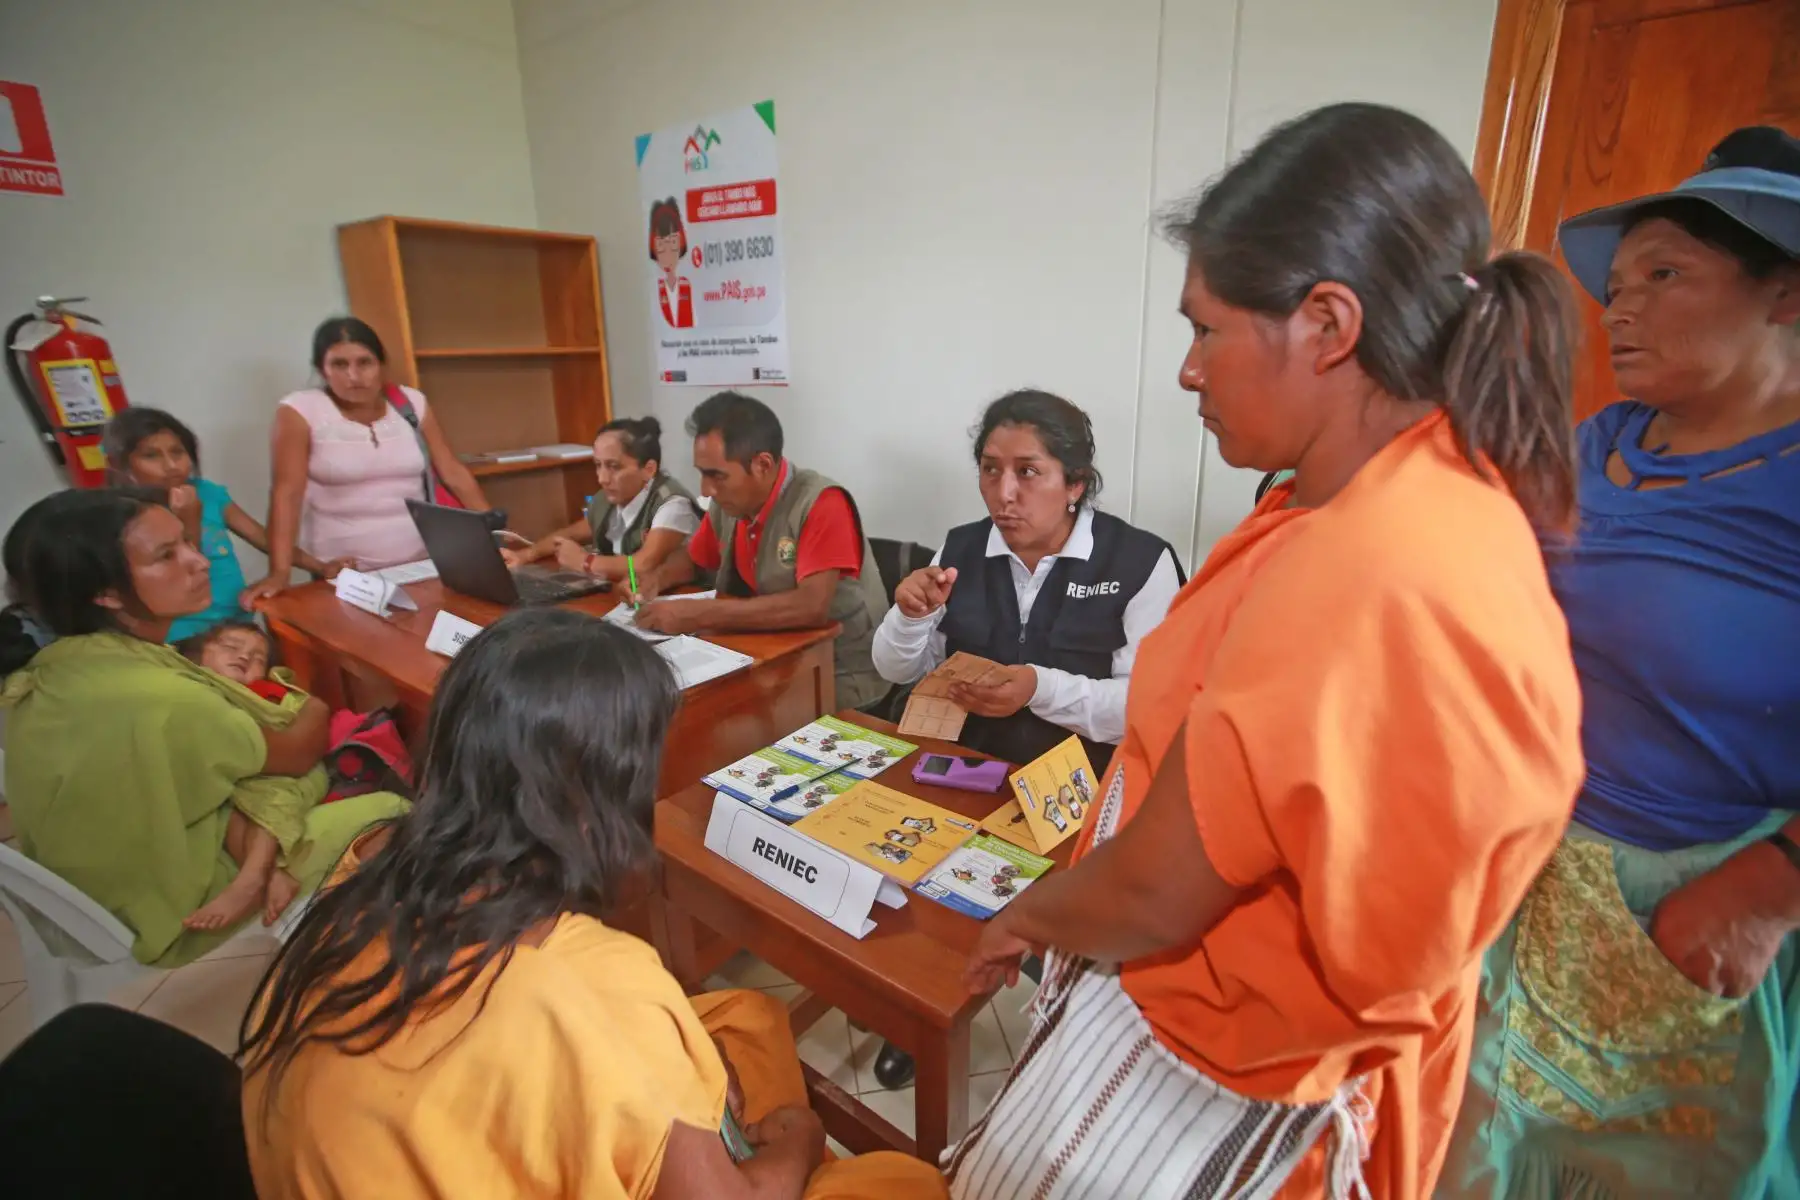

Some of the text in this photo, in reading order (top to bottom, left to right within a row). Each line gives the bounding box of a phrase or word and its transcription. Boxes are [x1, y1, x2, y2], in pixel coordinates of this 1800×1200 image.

[703, 236, 774, 268] (01) 390 6630
[1066, 581, 1120, 599] RENIEC
[752, 836, 818, 884] RENIEC
